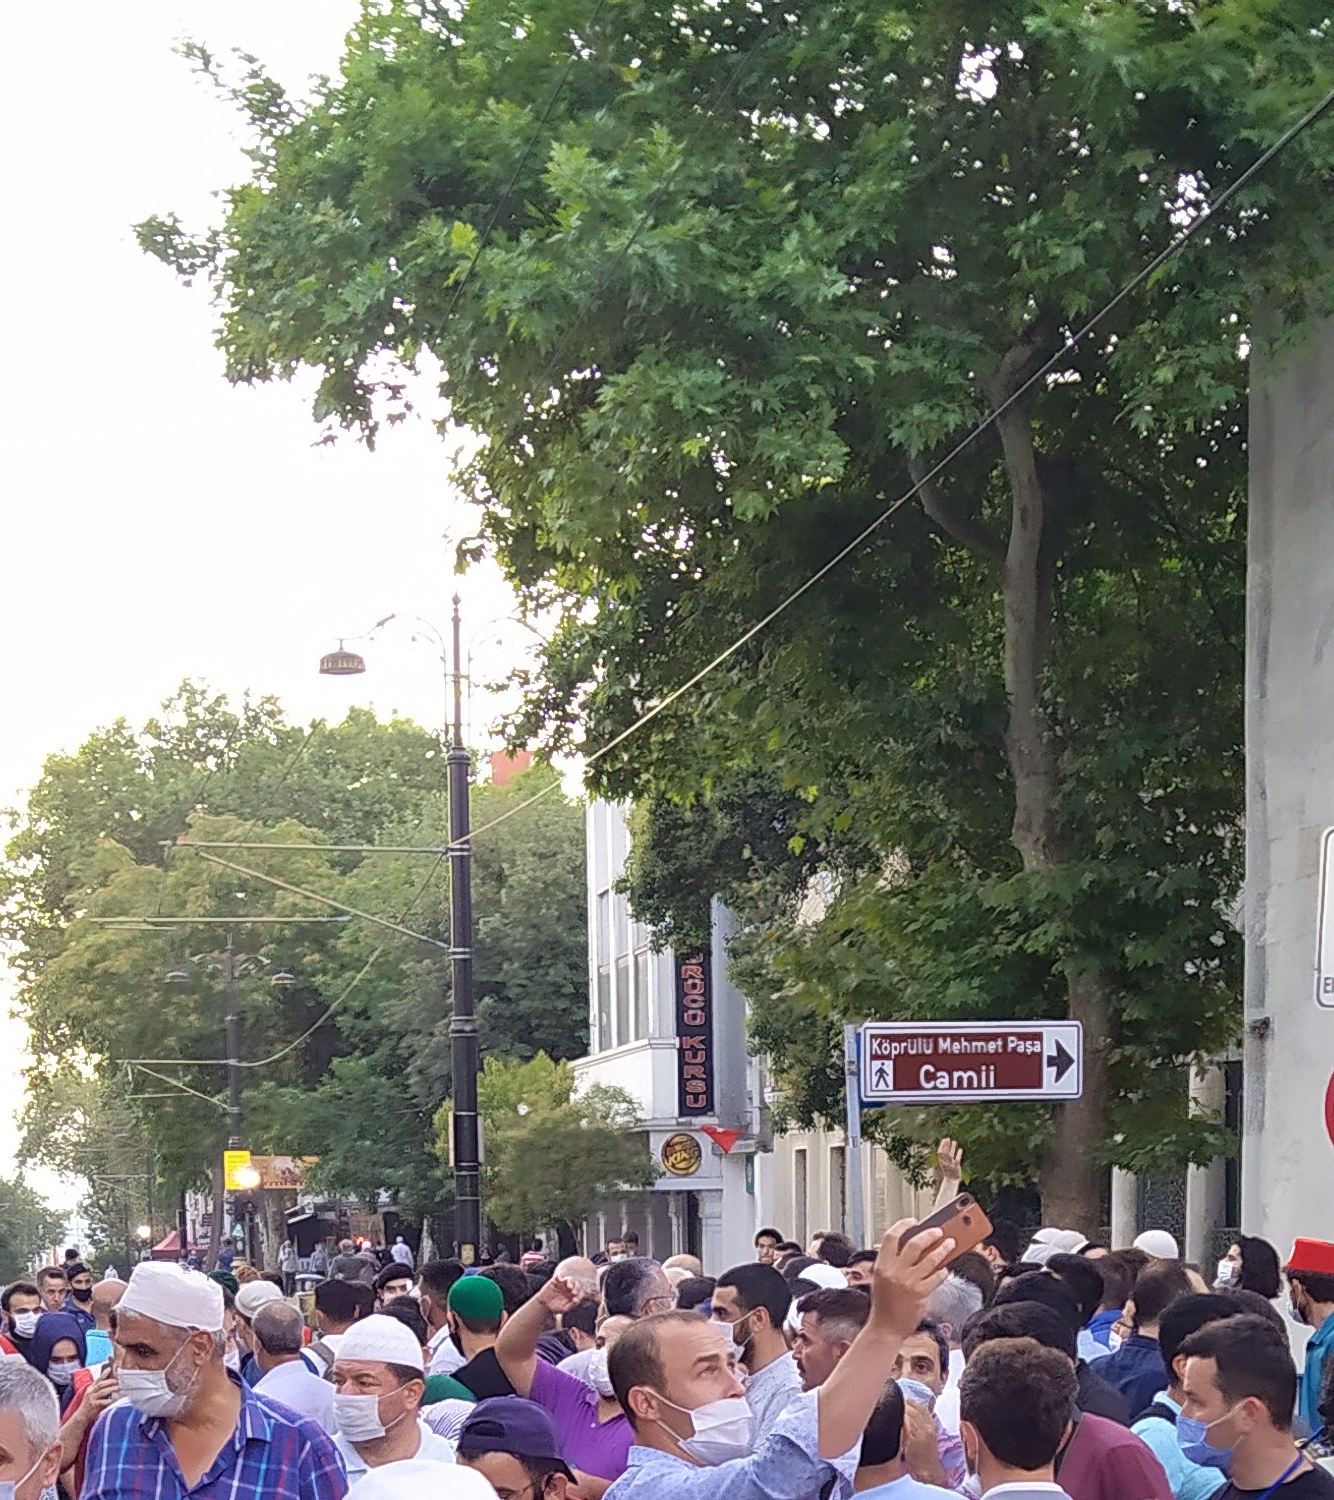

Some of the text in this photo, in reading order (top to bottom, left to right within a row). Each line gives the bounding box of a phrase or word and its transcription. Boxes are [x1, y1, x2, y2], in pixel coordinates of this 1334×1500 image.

[871, 1036, 1042, 1059] Köprülü Mehmet Paşa
[682, 1035, 707, 1109] KURSU
[919, 1063, 996, 1090] Camii
